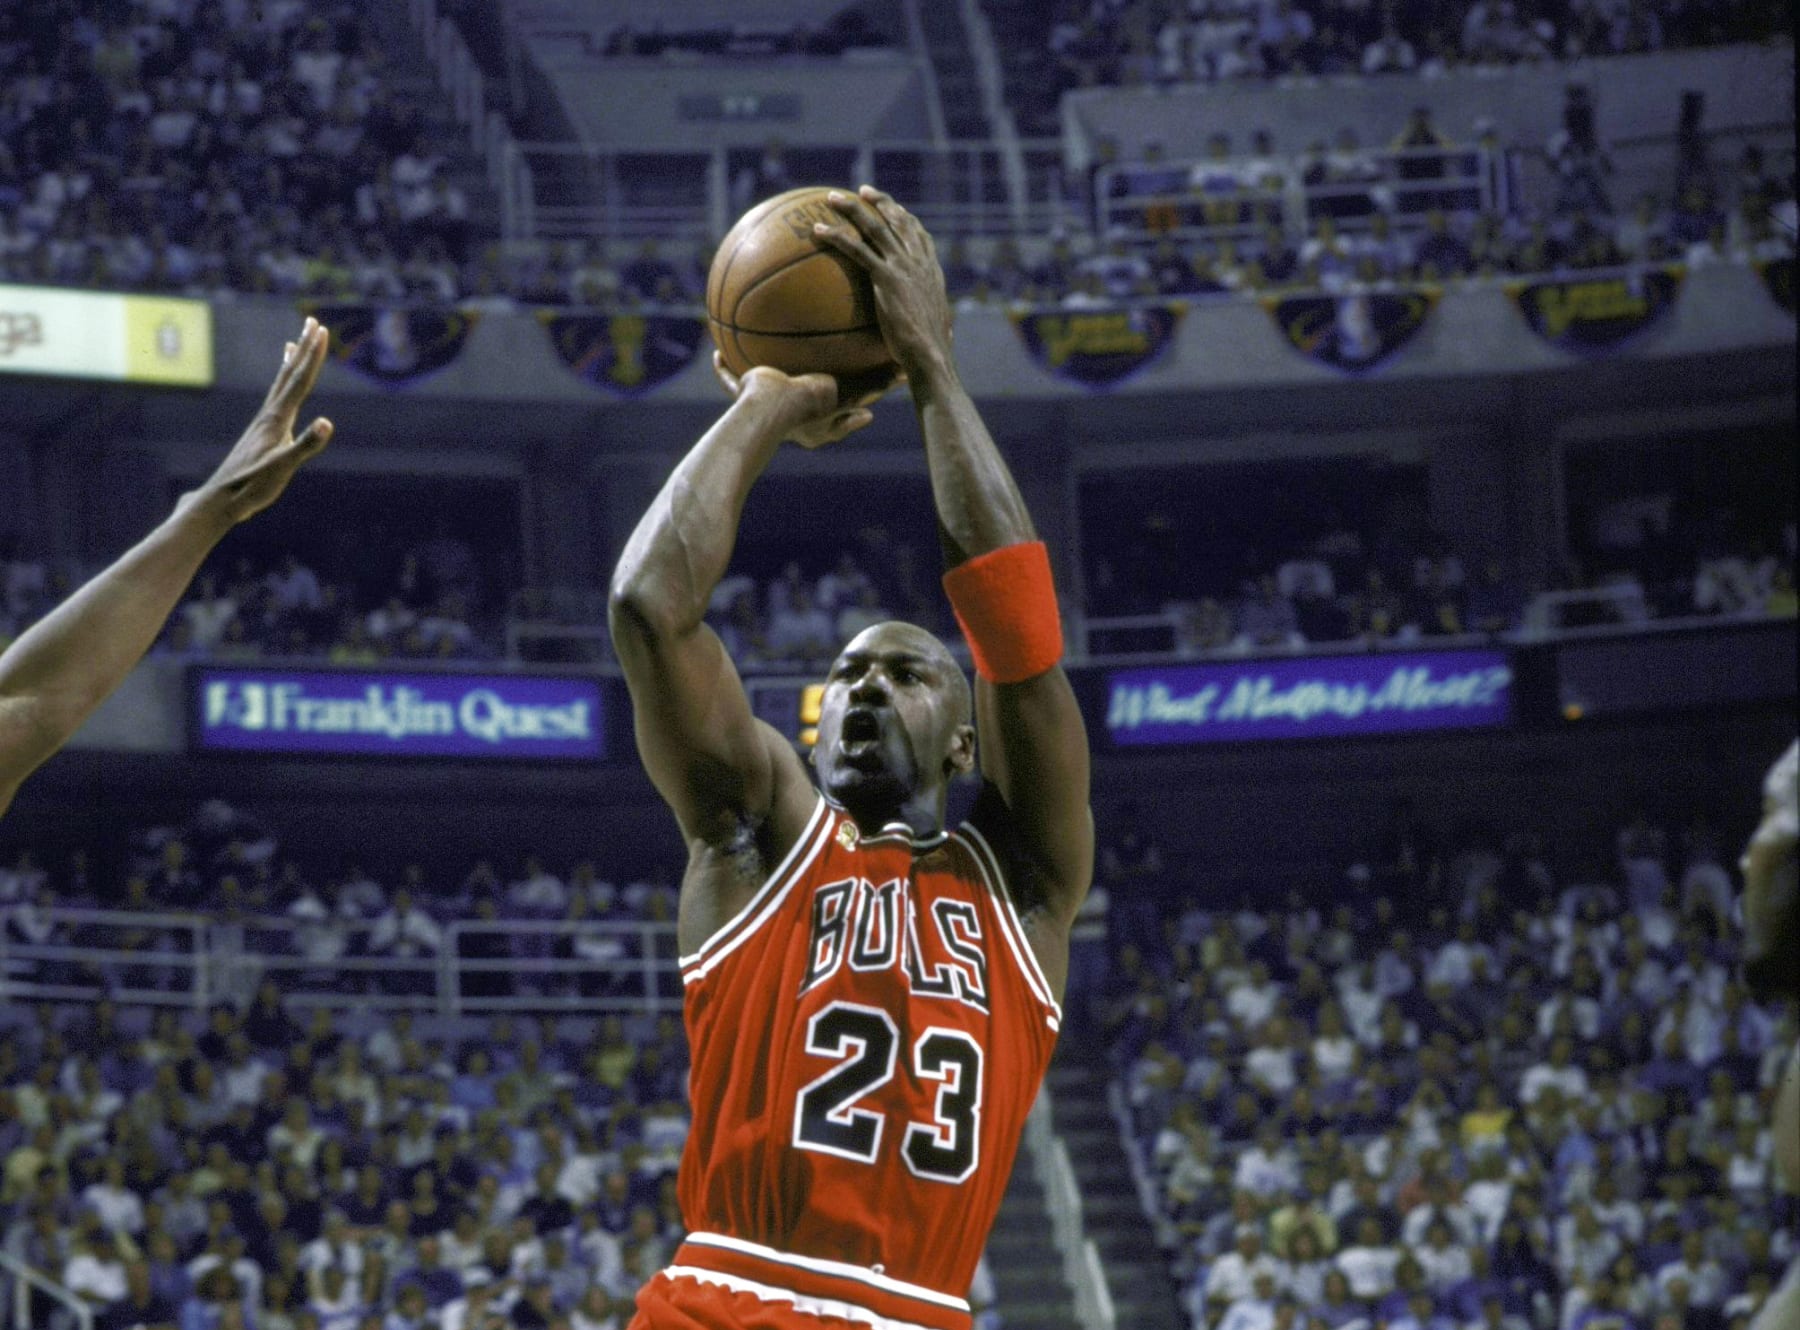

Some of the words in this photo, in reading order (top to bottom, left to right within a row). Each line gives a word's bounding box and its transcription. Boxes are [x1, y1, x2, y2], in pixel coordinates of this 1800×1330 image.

[271, 683, 454, 738] Franklin
[458, 688, 589, 742] Quest
[1107, 682, 1219, 730] What
[798, 876, 990, 1016] BULS
[792, 1000, 983, 1184] 23
